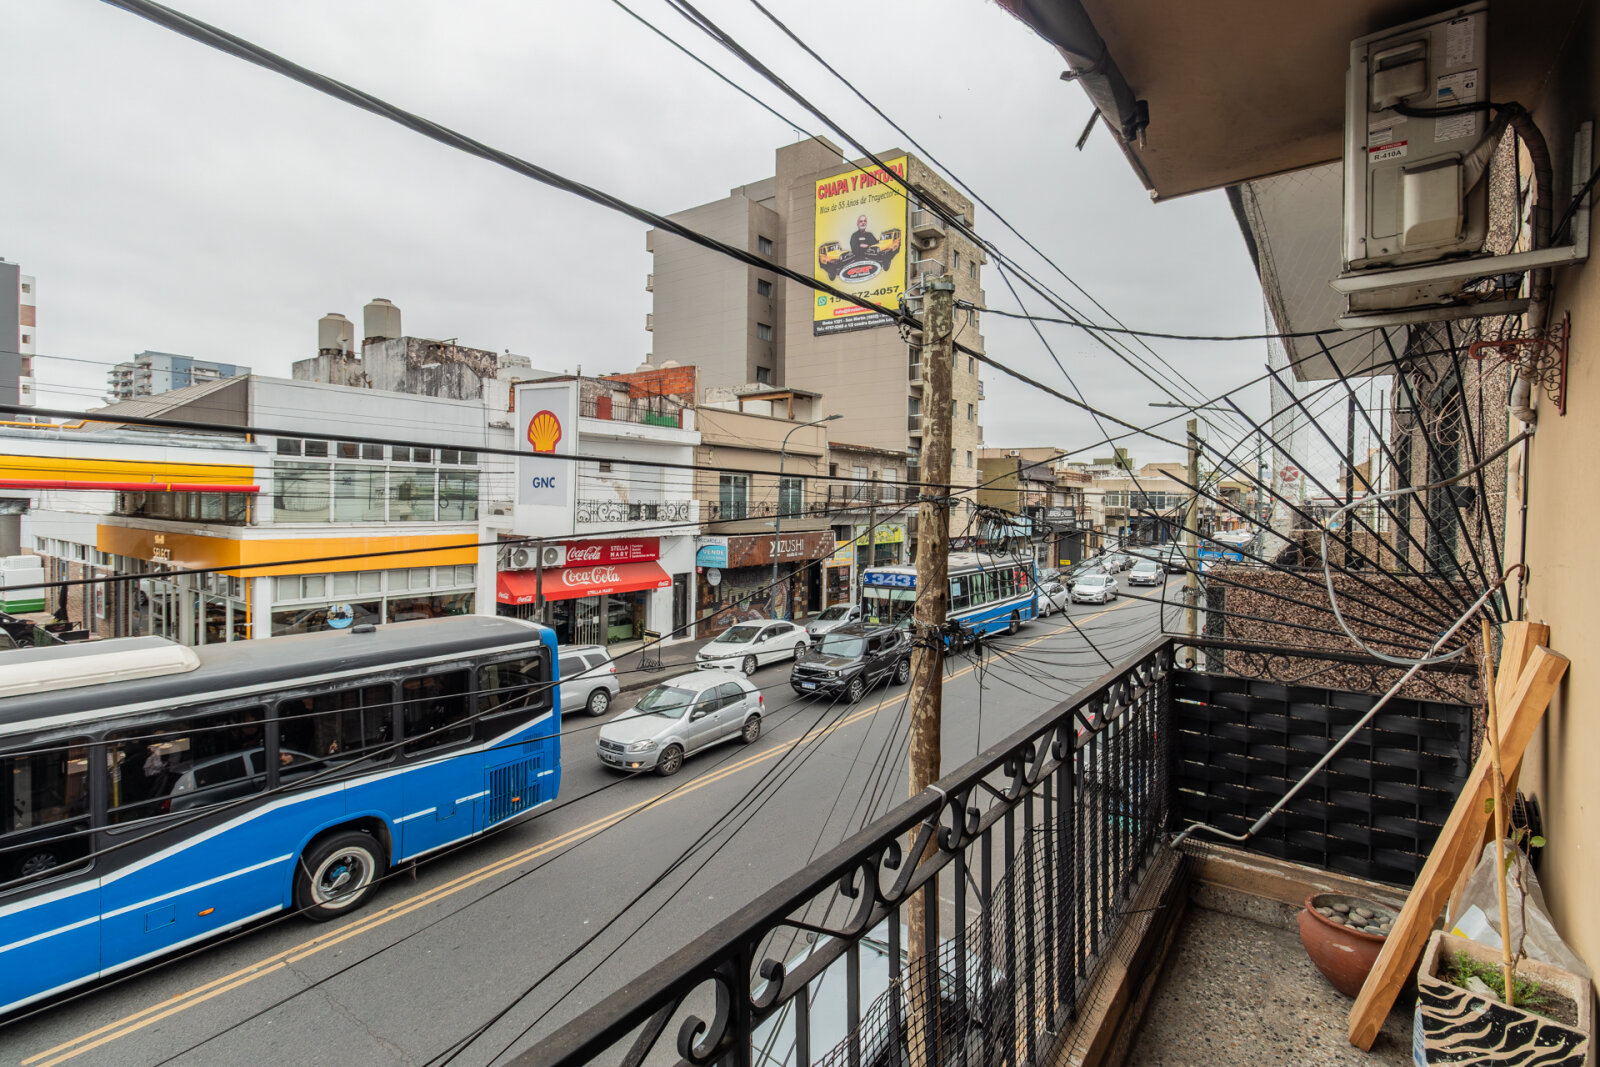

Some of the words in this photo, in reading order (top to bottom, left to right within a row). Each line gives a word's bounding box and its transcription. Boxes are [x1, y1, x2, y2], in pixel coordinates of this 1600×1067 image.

[1374, 150, 1402, 161] R-410A
[818, 179, 849, 200] CHAPA
[851, 175, 858, 191] Y
[860, 163, 904, 189] PINTURA
[860, 195, 867, 204] de
[532, 476, 556, 489] GNC
[153, 547, 171, 560] SELECT
[566, 545, 603, 562] Coca-Cola
[562, 566, 621, 587] Coca-Cola
[871, 573, 911, 587] 343
